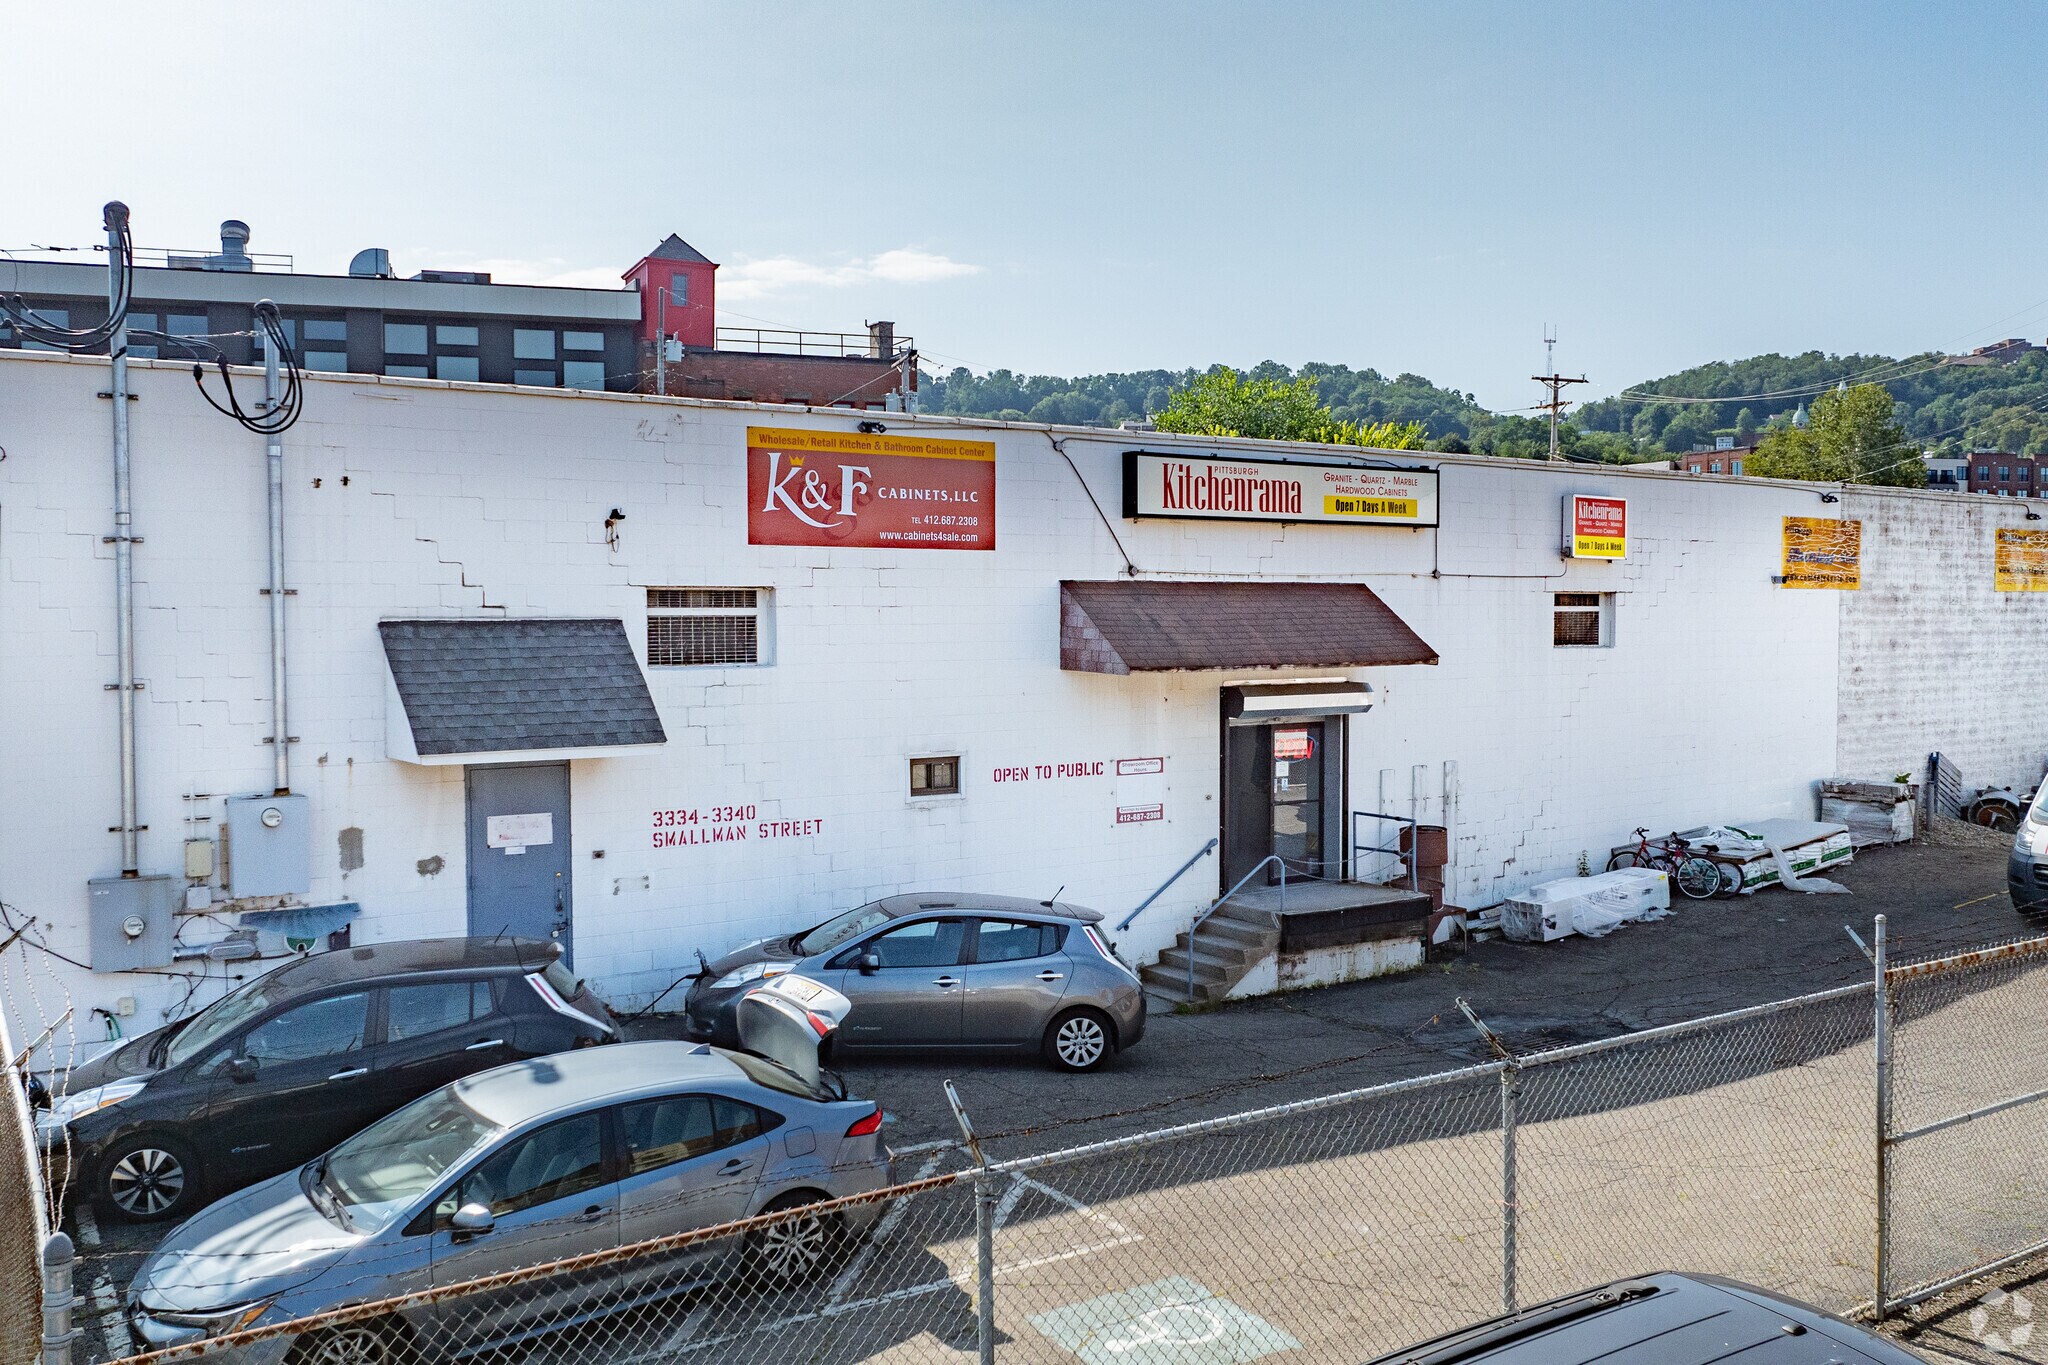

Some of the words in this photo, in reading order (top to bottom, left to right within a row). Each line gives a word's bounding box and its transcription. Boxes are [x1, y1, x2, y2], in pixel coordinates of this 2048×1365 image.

[759, 433, 836, 448] Wholesale/Retail
[840, 440, 872, 450] Kitchen
[874, 441, 881, 451] &
[884, 441, 924, 453] Bathroom
[926, 444, 957, 456] Cabinet
[960, 446, 985, 457] Center
[1214, 465, 1259, 476] PITTSBURGH
[1323, 472, 1352, 483] GRANITE
[1361, 474, 1385, 484] QUARTZ
[1394, 476, 1418, 486] MARBLE
[1162, 462, 1302, 514] Kitchenrama
[1335, 484, 1375, 495] HARDWOOD
[1378, 486, 1408, 496] CABINETS
[1335, 499, 1354, 512] Open
[1356, 500, 1360, 512] 7
[1362, 500, 1378, 514] Days
[1381, 501, 1386, 513] A
[1388, 501, 1407, 514] Week
[1578, 501, 1622, 521] Kitchenrama
[924, 515, 978, 526] 412.687.2308
[880, 531, 978, 542] www.cabinets4sale.com
[1578, 541, 1589, 550] Open
[1594, 541, 1605, 551] Days
[1610, 542, 1622, 551] Week
[993, 766, 1029, 783] OPEN
[1035, 764, 1052, 780] TO
[1057, 761, 1104, 778] PUBLIC
[653, 805, 756, 828] 3334-3340
[653, 825, 747, 848] SMALLMAN
[759, 819, 823, 839] STREET
